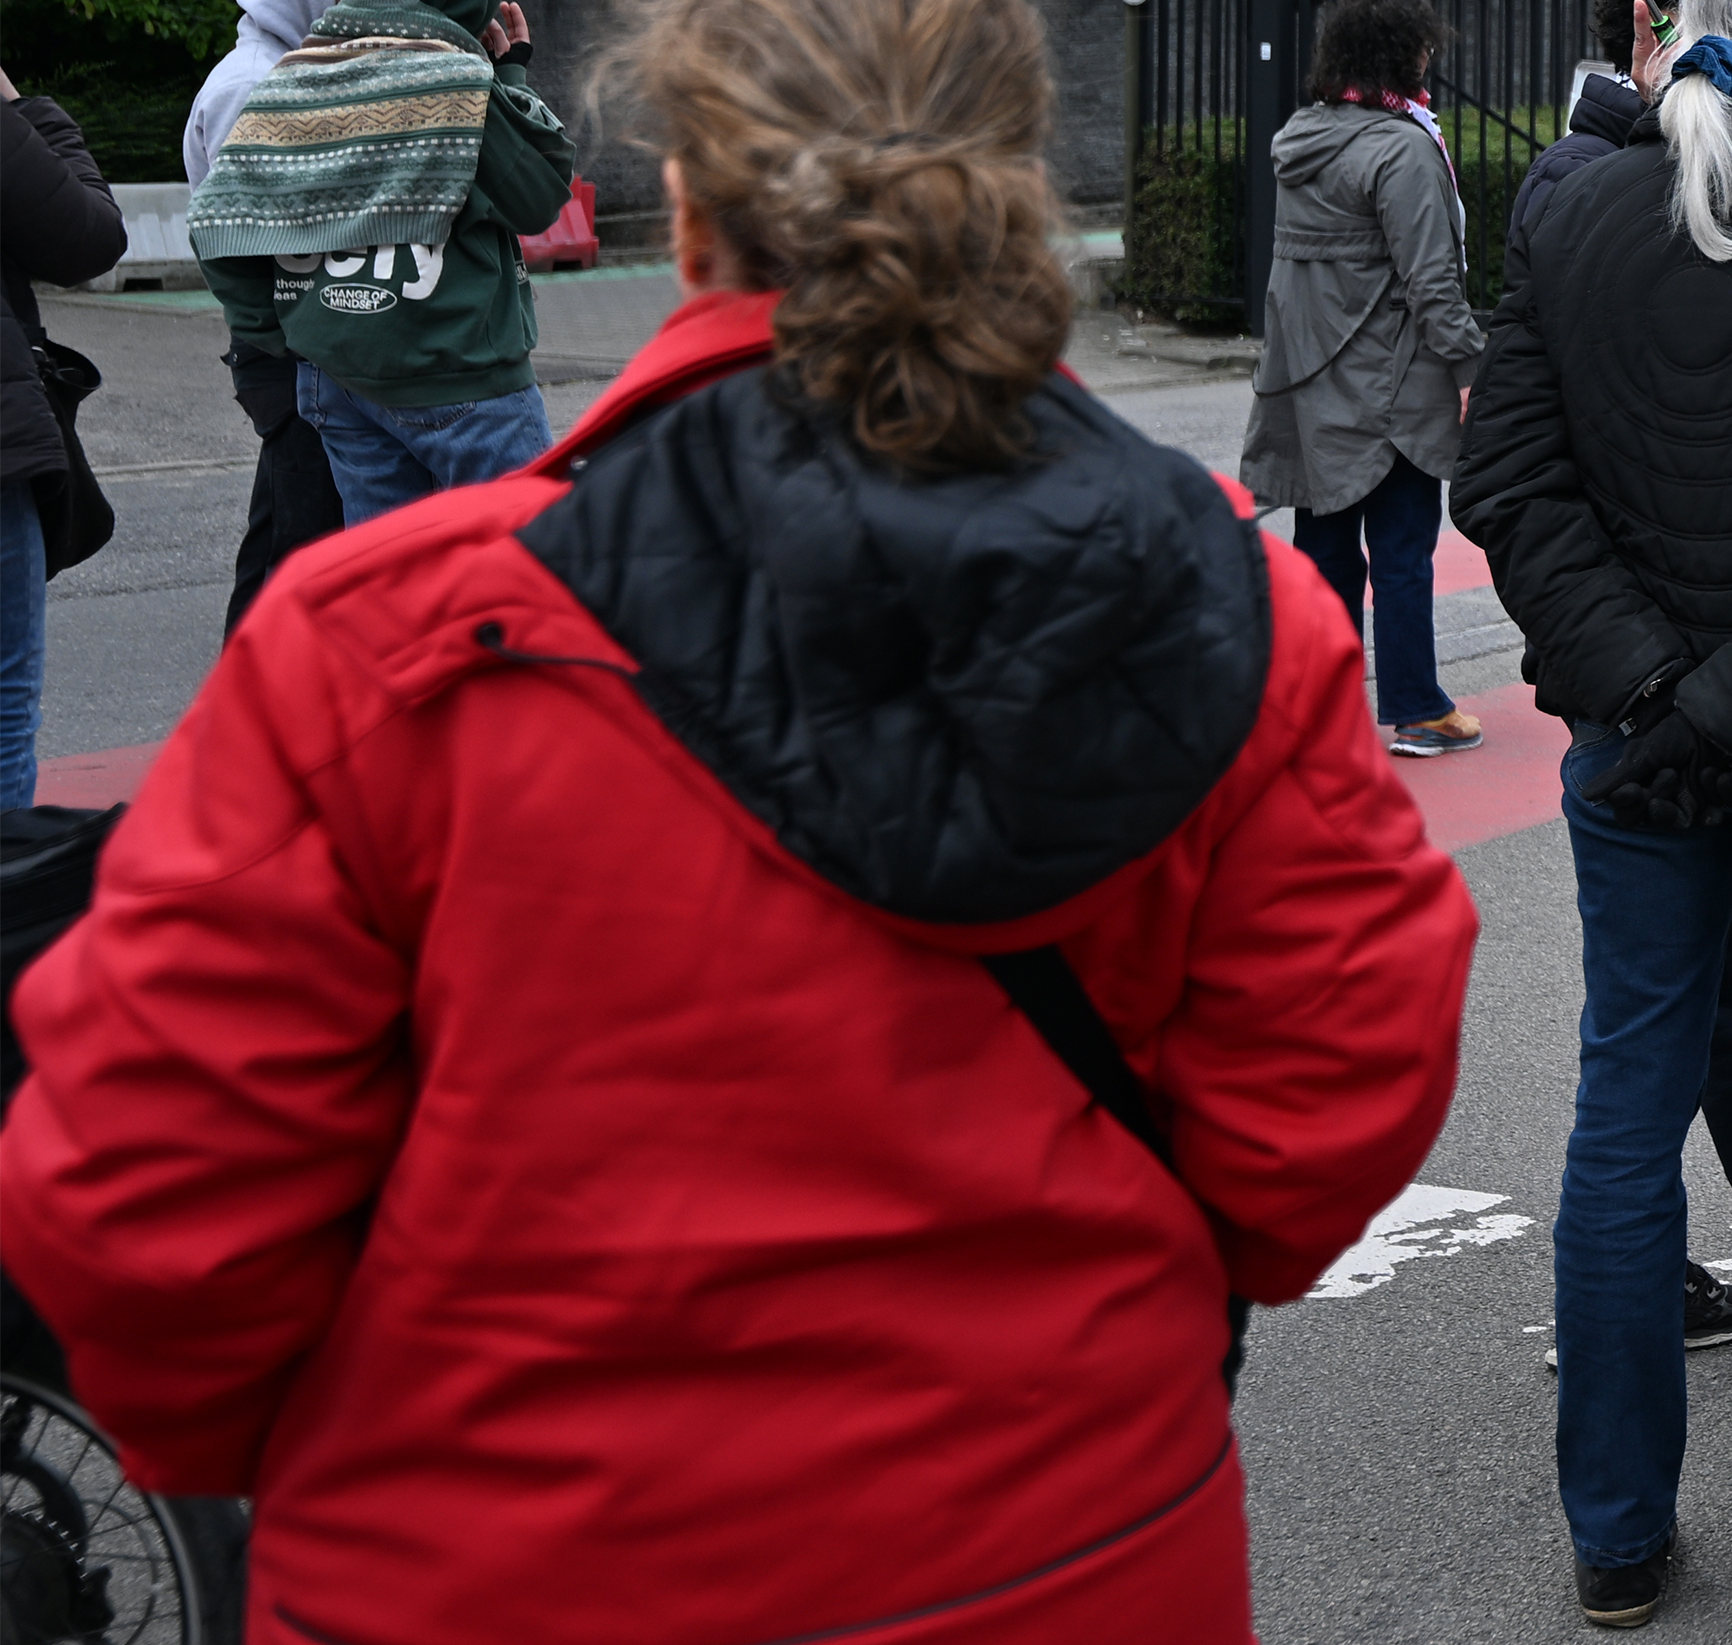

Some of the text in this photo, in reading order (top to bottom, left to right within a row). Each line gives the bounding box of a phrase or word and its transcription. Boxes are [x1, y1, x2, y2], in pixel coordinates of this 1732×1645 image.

[323, 286, 388, 302] CHANGE OF
[329, 297, 380, 310] MINDSET
